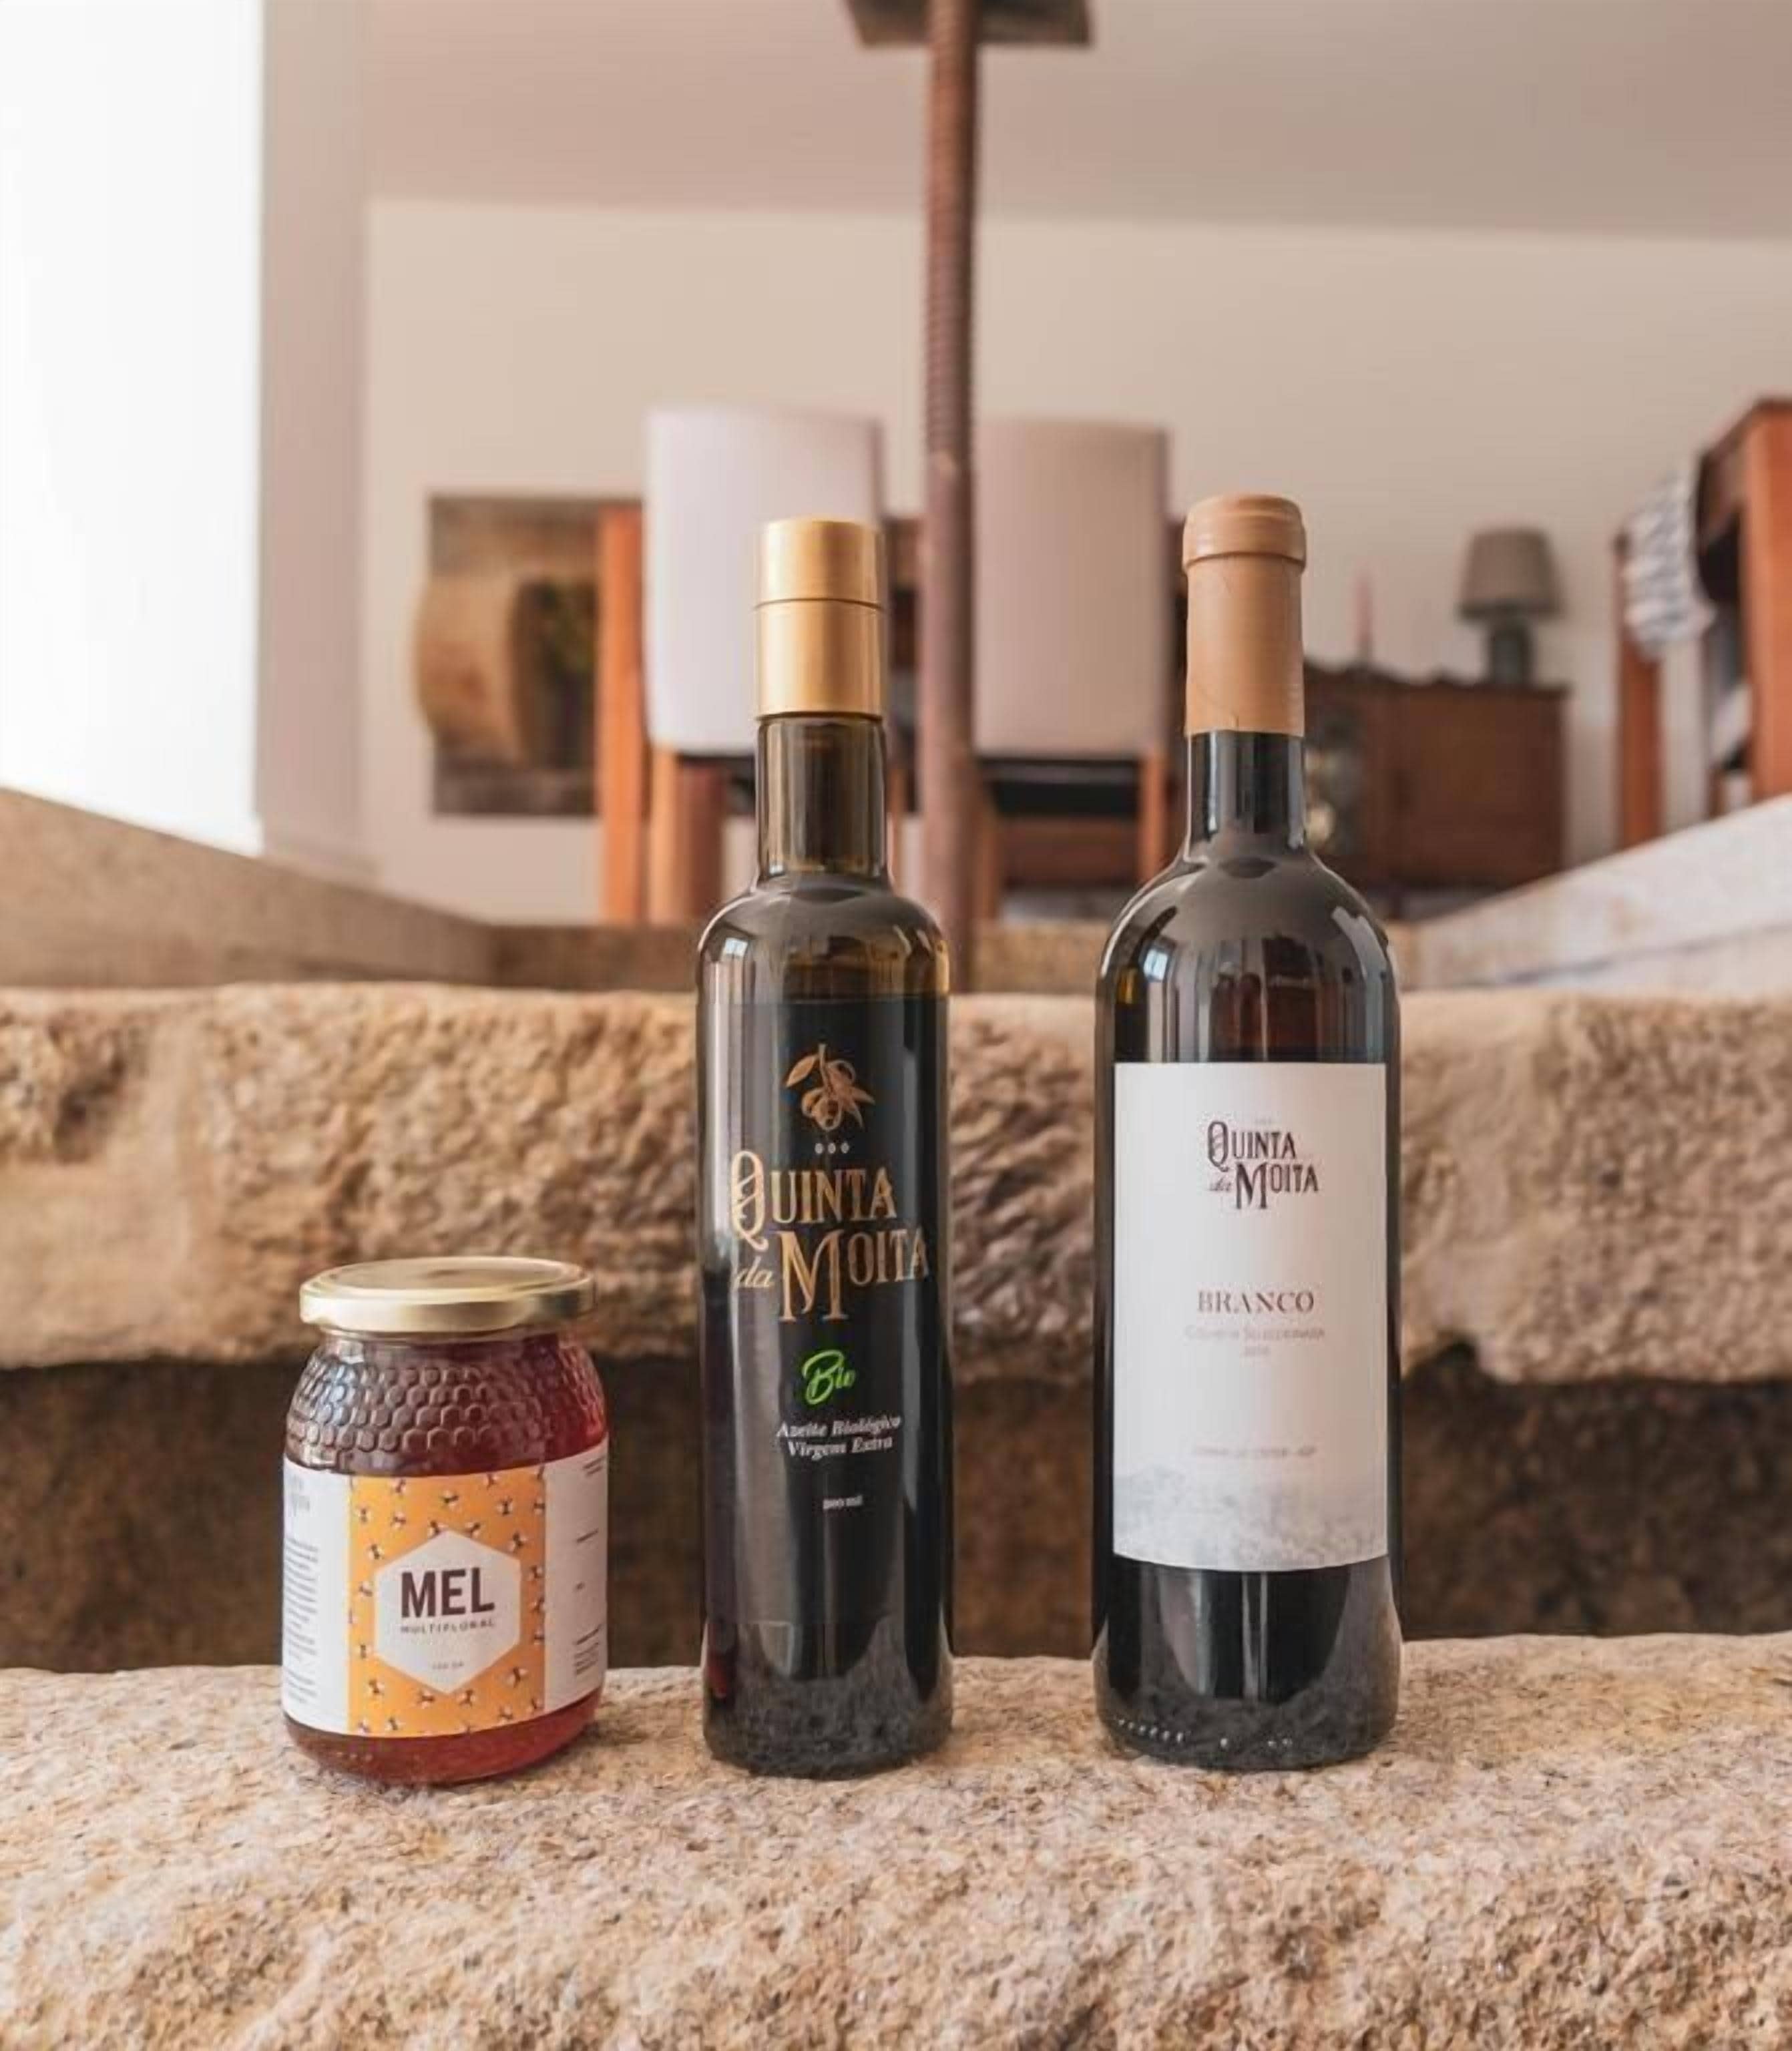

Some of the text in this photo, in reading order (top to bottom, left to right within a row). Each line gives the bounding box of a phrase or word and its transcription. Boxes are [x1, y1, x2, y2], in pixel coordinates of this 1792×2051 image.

[1207, 1120, 1297, 1172] QUINTA
[731, 1150, 898, 1251] QUINTA
[1235, 1161, 1320, 1210] MOITA
[736, 1226, 929, 1323] da MOITA
[1198, 1291, 1315, 1315] BRANCO
[802, 1349, 856, 1405] Bio
[788, 1436, 893, 1461] Virgem Extra
[401, 1567, 495, 1618] MEL
